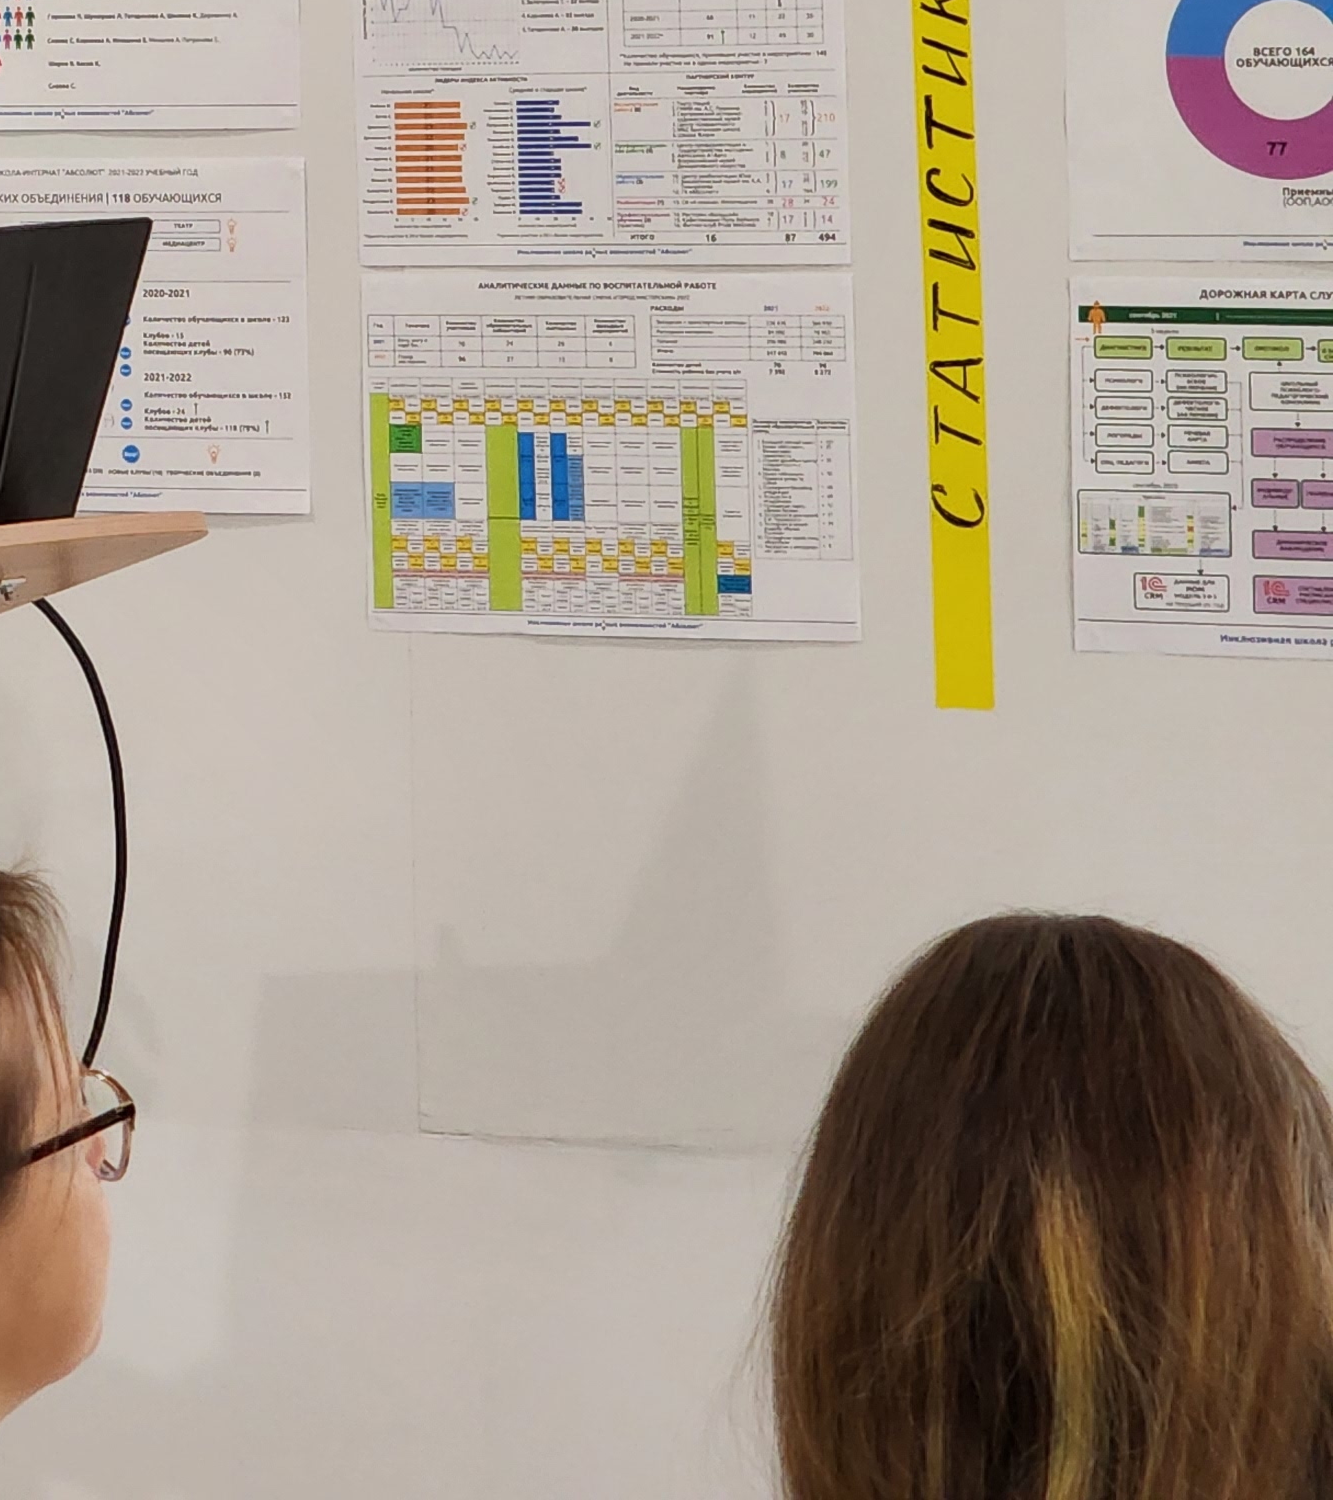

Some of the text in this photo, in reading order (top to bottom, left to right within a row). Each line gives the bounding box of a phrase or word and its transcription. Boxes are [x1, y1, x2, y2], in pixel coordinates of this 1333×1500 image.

[1253, 47, 1315, 56] ВСЕГО 164
[1266, 142, 1288, 156] 77
[21, 193, 104, 204] ОБЪЕДИНЕНИЯ
[112, 193, 131, 203] 118
[133, 193, 222, 204] ОБУЧАЮЩИХСЯ
[705, 234, 717, 242] 16
[784, 233, 796, 242] 87
[818, 233, 836, 242] 494
[143, 288, 190, 298] 2020-2021
[1199, 290, 1267, 300] ДОРОЖНАЯ
[1270, 290, 1307, 300] КАРТА
[144, 373, 192, 382] 2021-2022
